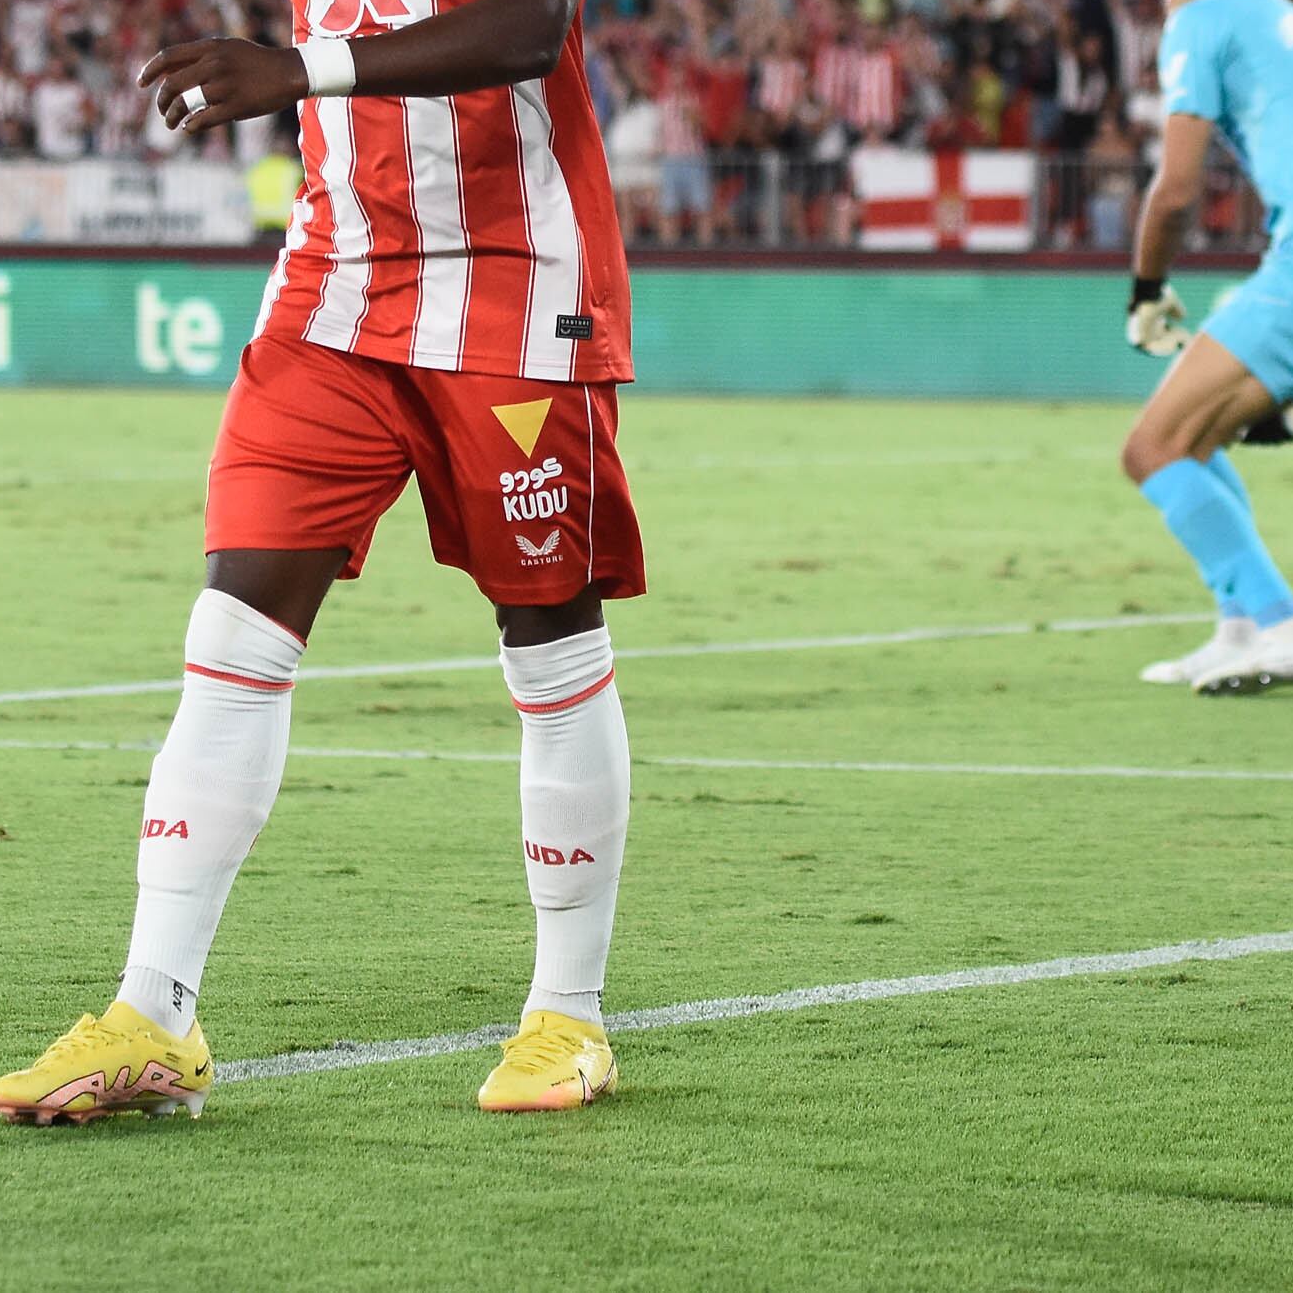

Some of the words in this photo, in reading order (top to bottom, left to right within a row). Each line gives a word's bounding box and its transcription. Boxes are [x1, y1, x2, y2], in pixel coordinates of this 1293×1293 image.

[136, 282, 223, 375] te
[502, 485, 568, 522] KUDU
[141, 818, 189, 839] DA
[525, 839, 595, 865] UDA
